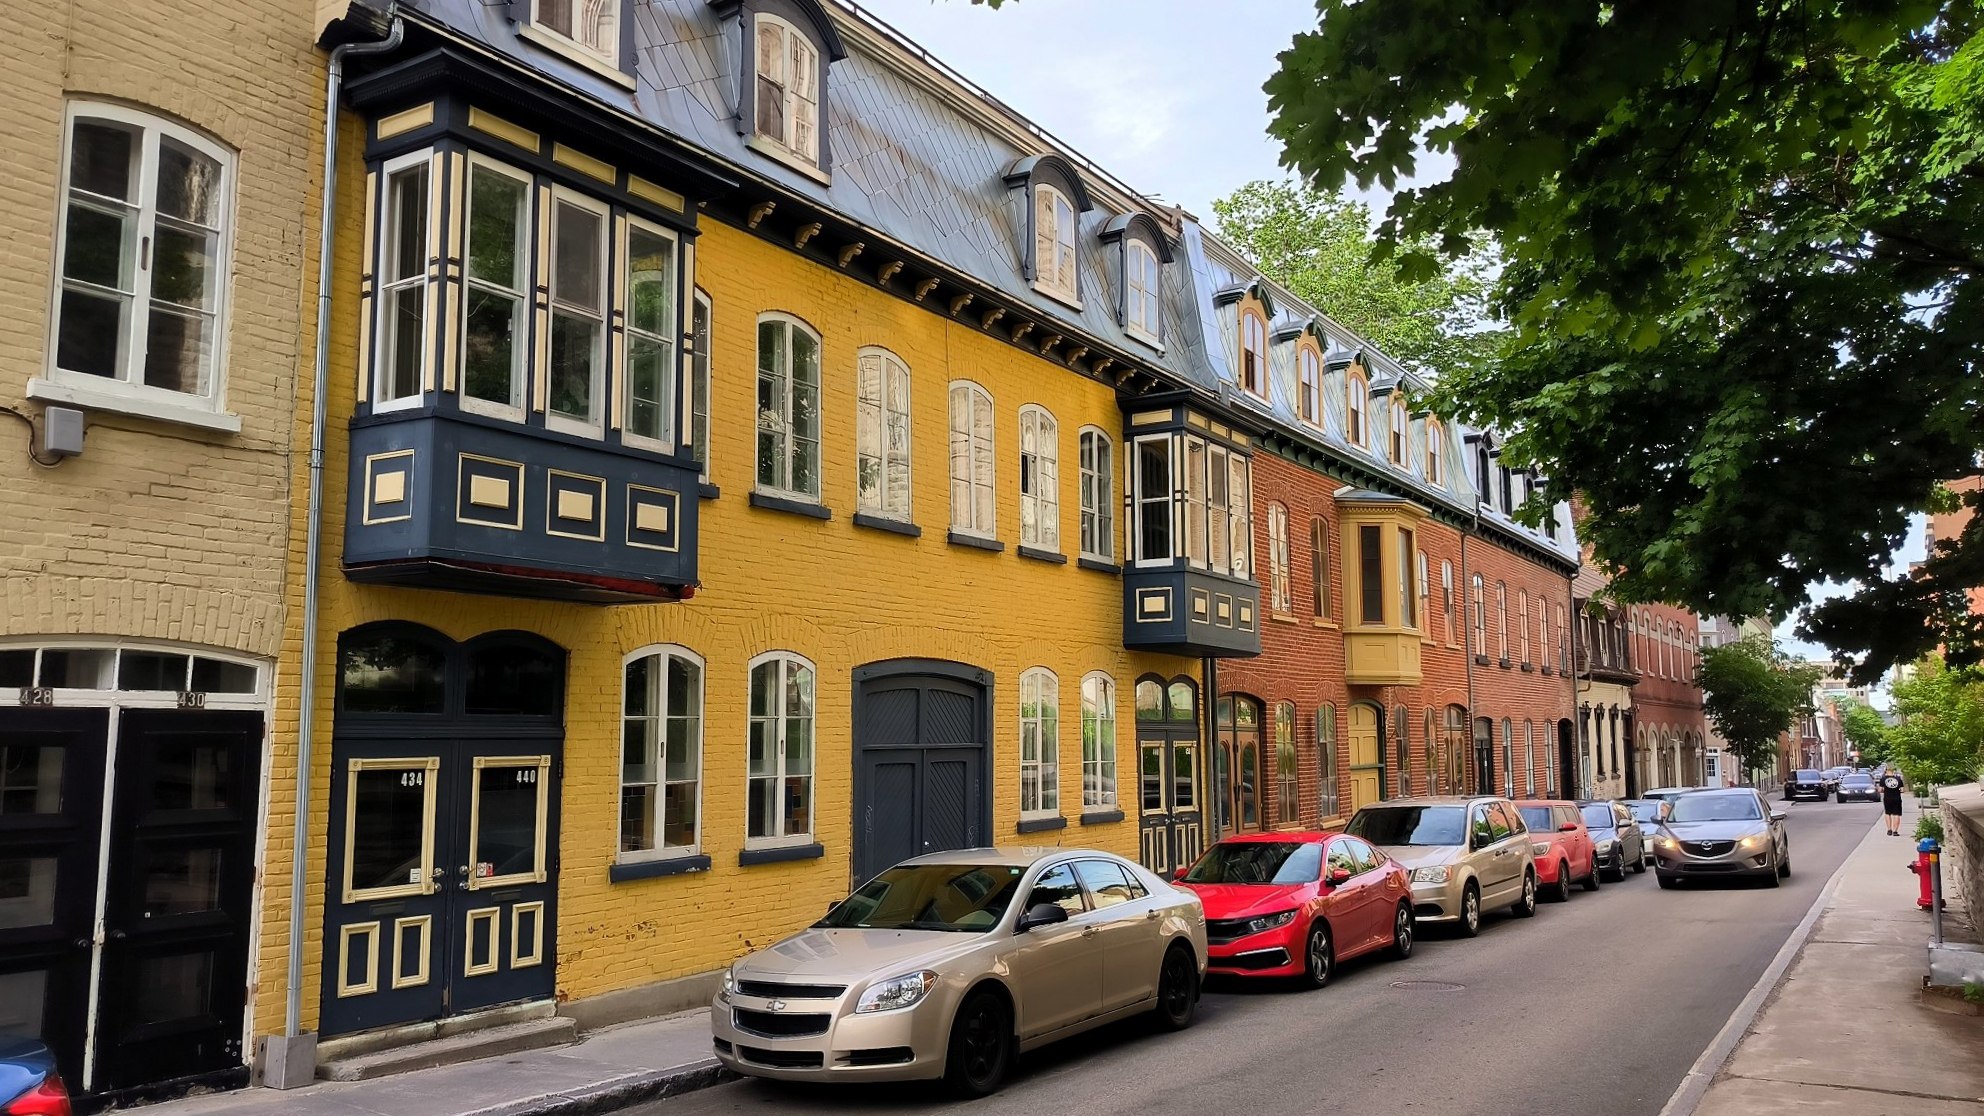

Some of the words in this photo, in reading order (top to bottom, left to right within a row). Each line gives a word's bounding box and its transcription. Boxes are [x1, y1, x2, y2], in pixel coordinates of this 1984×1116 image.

[21, 690, 52, 705] 428
[179, 693, 205, 707] 430
[401, 772, 422, 786] 434
[516, 770, 536, 783] 440
